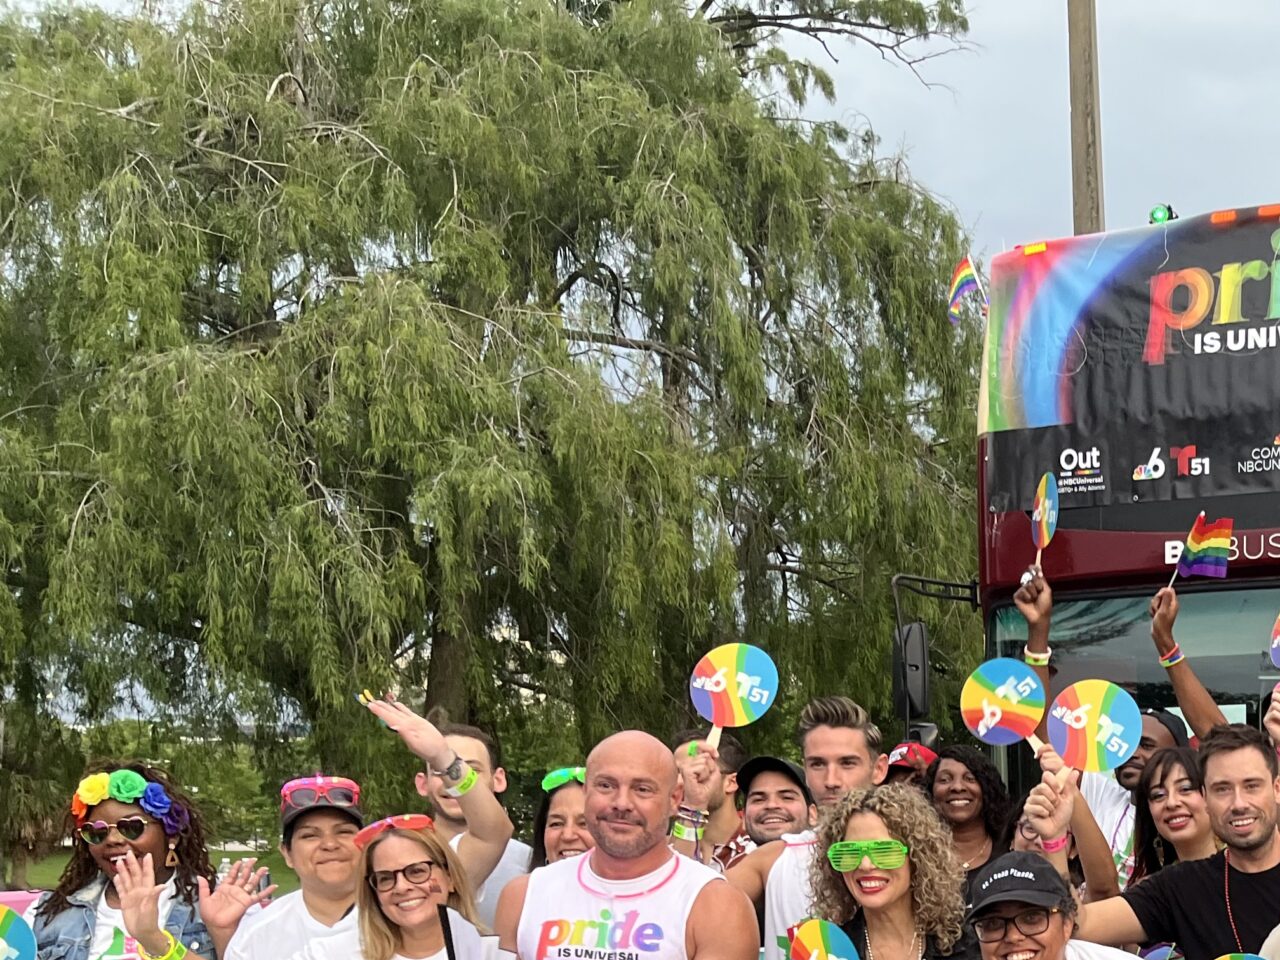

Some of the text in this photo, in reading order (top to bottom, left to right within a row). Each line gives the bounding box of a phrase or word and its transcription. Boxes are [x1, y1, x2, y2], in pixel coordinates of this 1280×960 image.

[1194, 332, 1221, 354] IS
[1060, 447, 1101, 470] Out
[557, 948, 571, 958] IS
